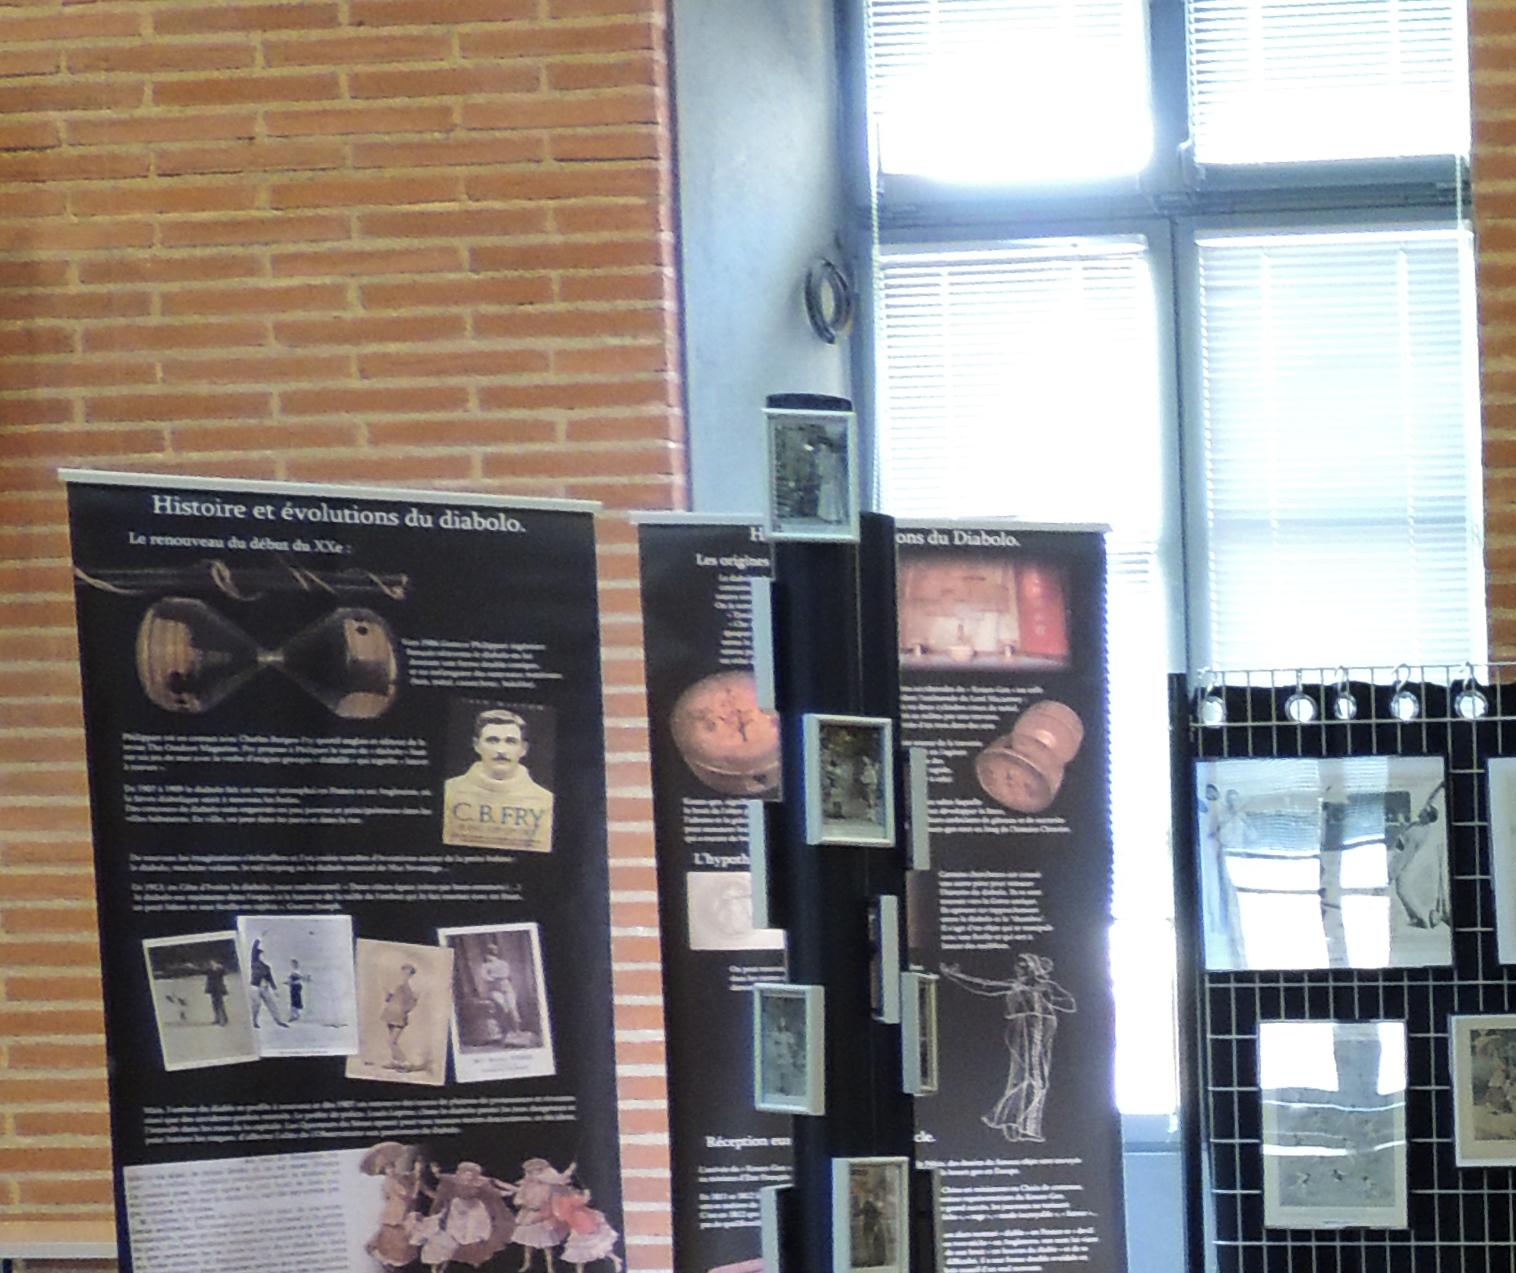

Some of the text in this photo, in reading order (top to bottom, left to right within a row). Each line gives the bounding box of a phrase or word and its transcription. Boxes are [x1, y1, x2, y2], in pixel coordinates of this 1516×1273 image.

[151, 494, 528, 533] Histoire et évolutions du diabolo.
[128, 531, 146, 546] Le
[149, 533, 225, 549] renouveau
[227, 535, 247, 551] du
[249, 535, 290, 552] début
[292, 537, 312, 553] du
[926, 529, 950, 546] du
[952, 529, 1022, 547] Diabolo.
[695, 552, 771, 570] Les origines
[500, 805, 546, 829] FRY
[705, 1135, 769, 1151] Réception
